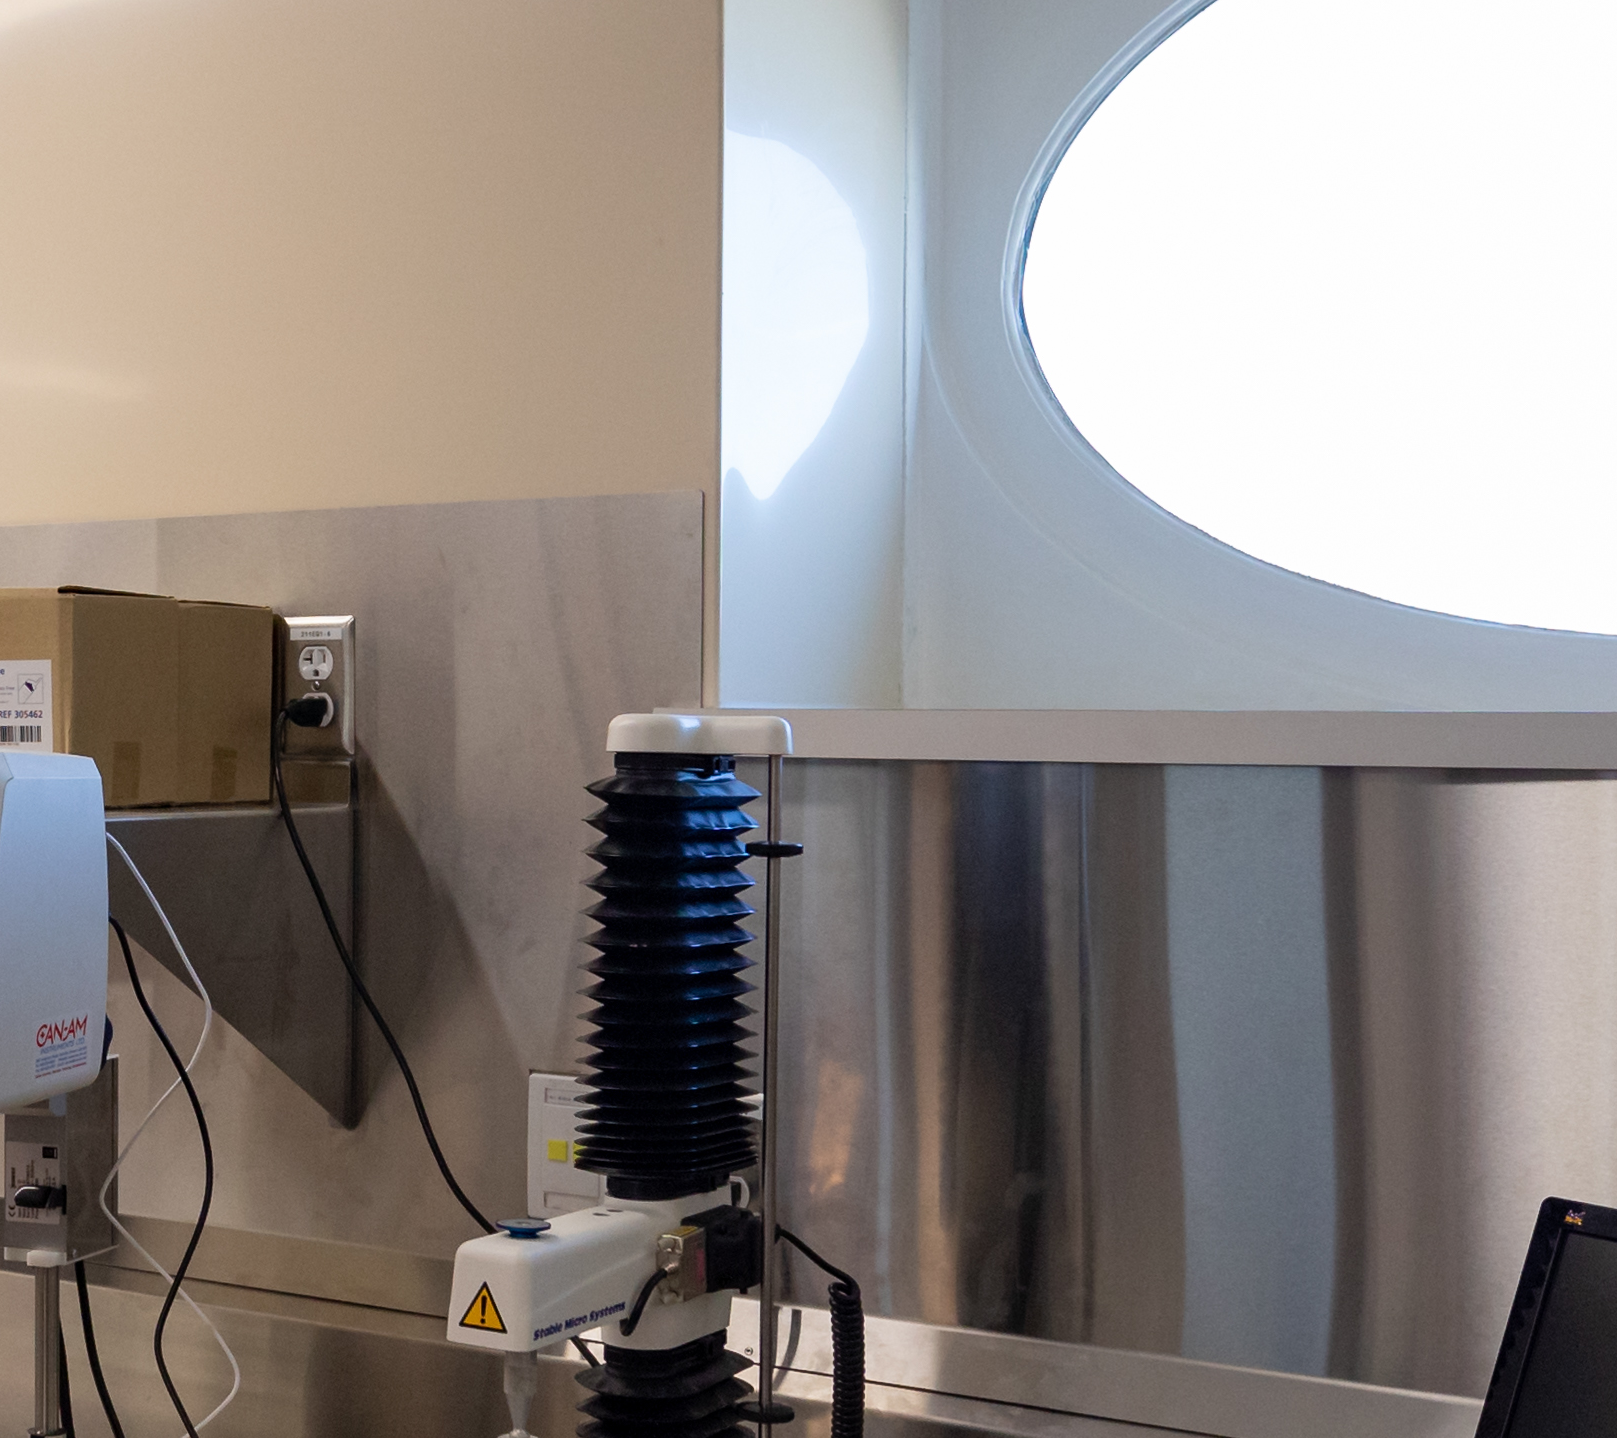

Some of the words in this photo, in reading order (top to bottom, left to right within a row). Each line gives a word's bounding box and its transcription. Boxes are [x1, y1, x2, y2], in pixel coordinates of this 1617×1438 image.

[14, 710, 43, 718] 305462
[533, 1322, 563, 1341] Stable
[564, 1314, 588, 1330] Micro
[589, 1302, 626, 1322] Systems
